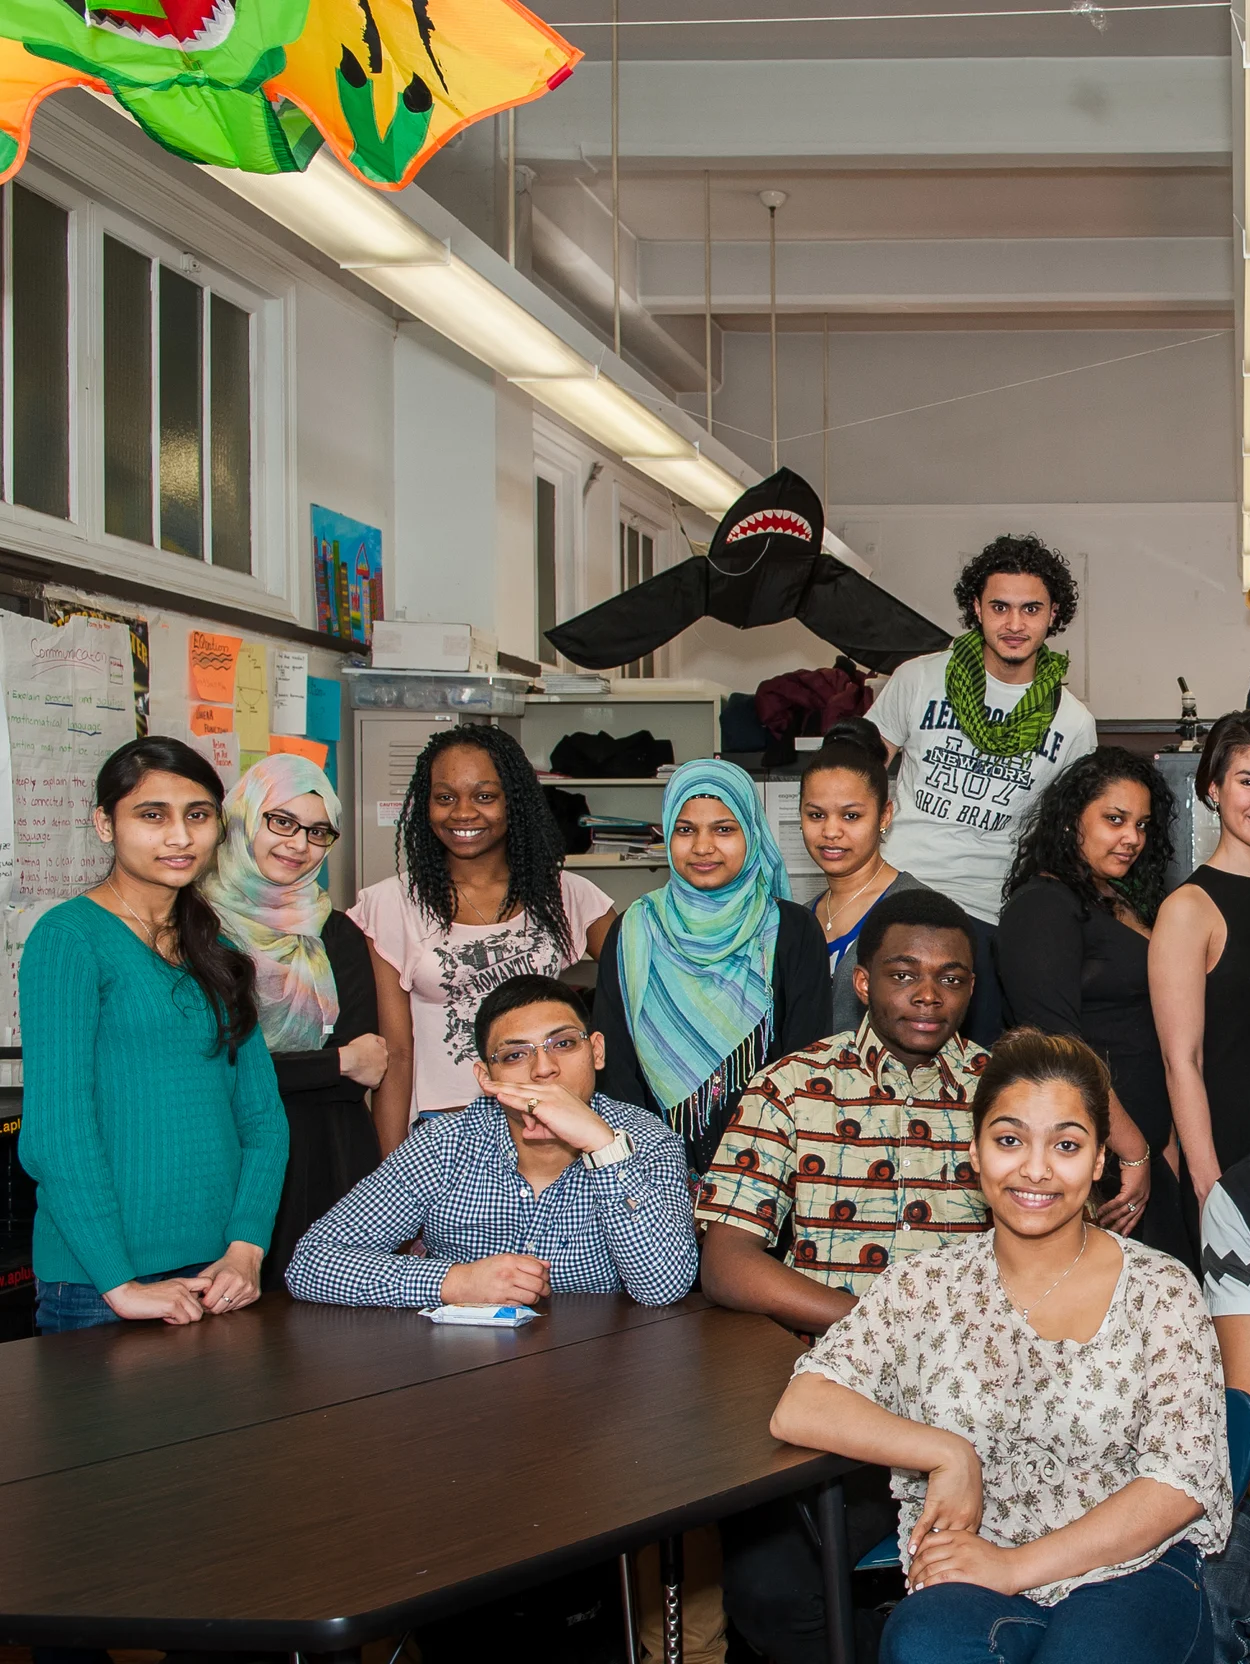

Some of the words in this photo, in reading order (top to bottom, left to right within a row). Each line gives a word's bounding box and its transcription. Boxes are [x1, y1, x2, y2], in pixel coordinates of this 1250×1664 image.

[933, 748, 977, 771] NEW
[982, 762, 1030, 784] YORK
[915, 789, 952, 821] ORIG.
[472, 952, 539, 994] ROMANTIC
